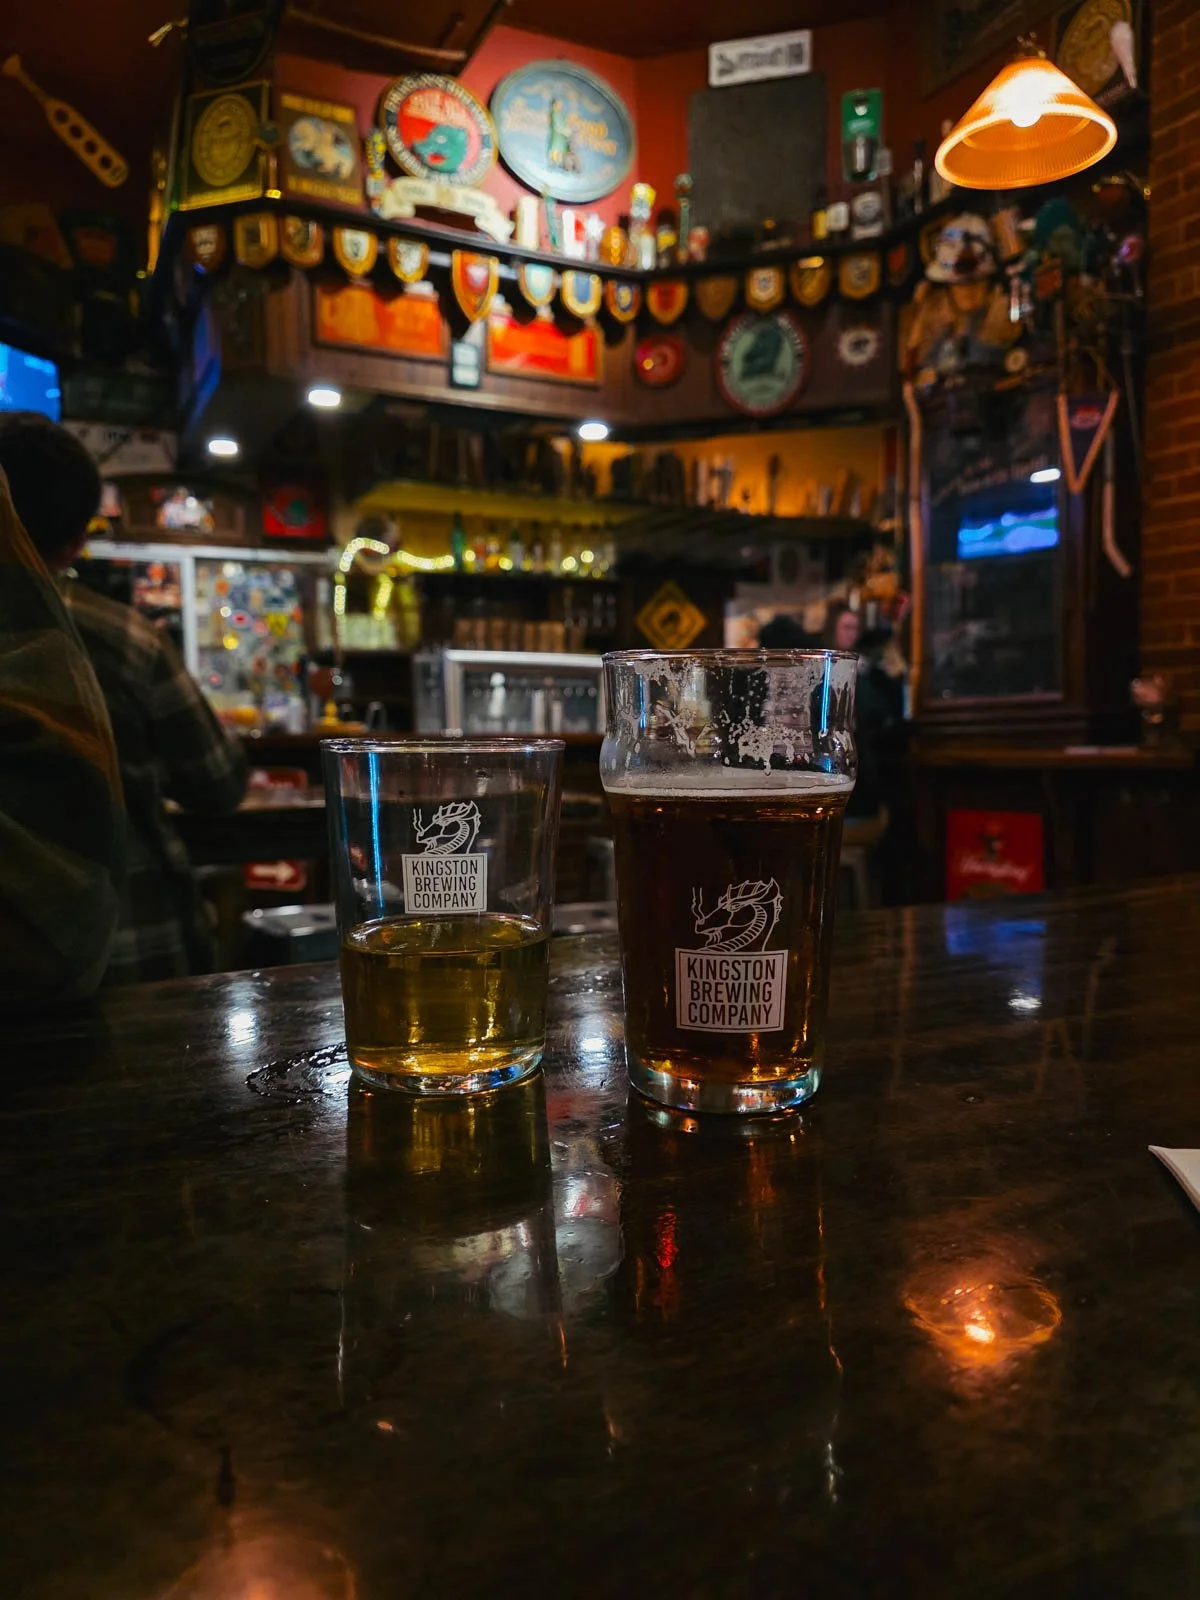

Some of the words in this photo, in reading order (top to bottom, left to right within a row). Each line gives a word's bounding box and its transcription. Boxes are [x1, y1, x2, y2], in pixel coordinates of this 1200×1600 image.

[412, 859, 478, 876] KINGSTON
[415, 875, 476, 892] BREWING
[414, 892, 477, 908] COMPANY
[687, 957, 776, 981] KINGSTON
[690, 980, 773, 1003] BREWING
[688, 1002, 773, 1025] COMPANY
